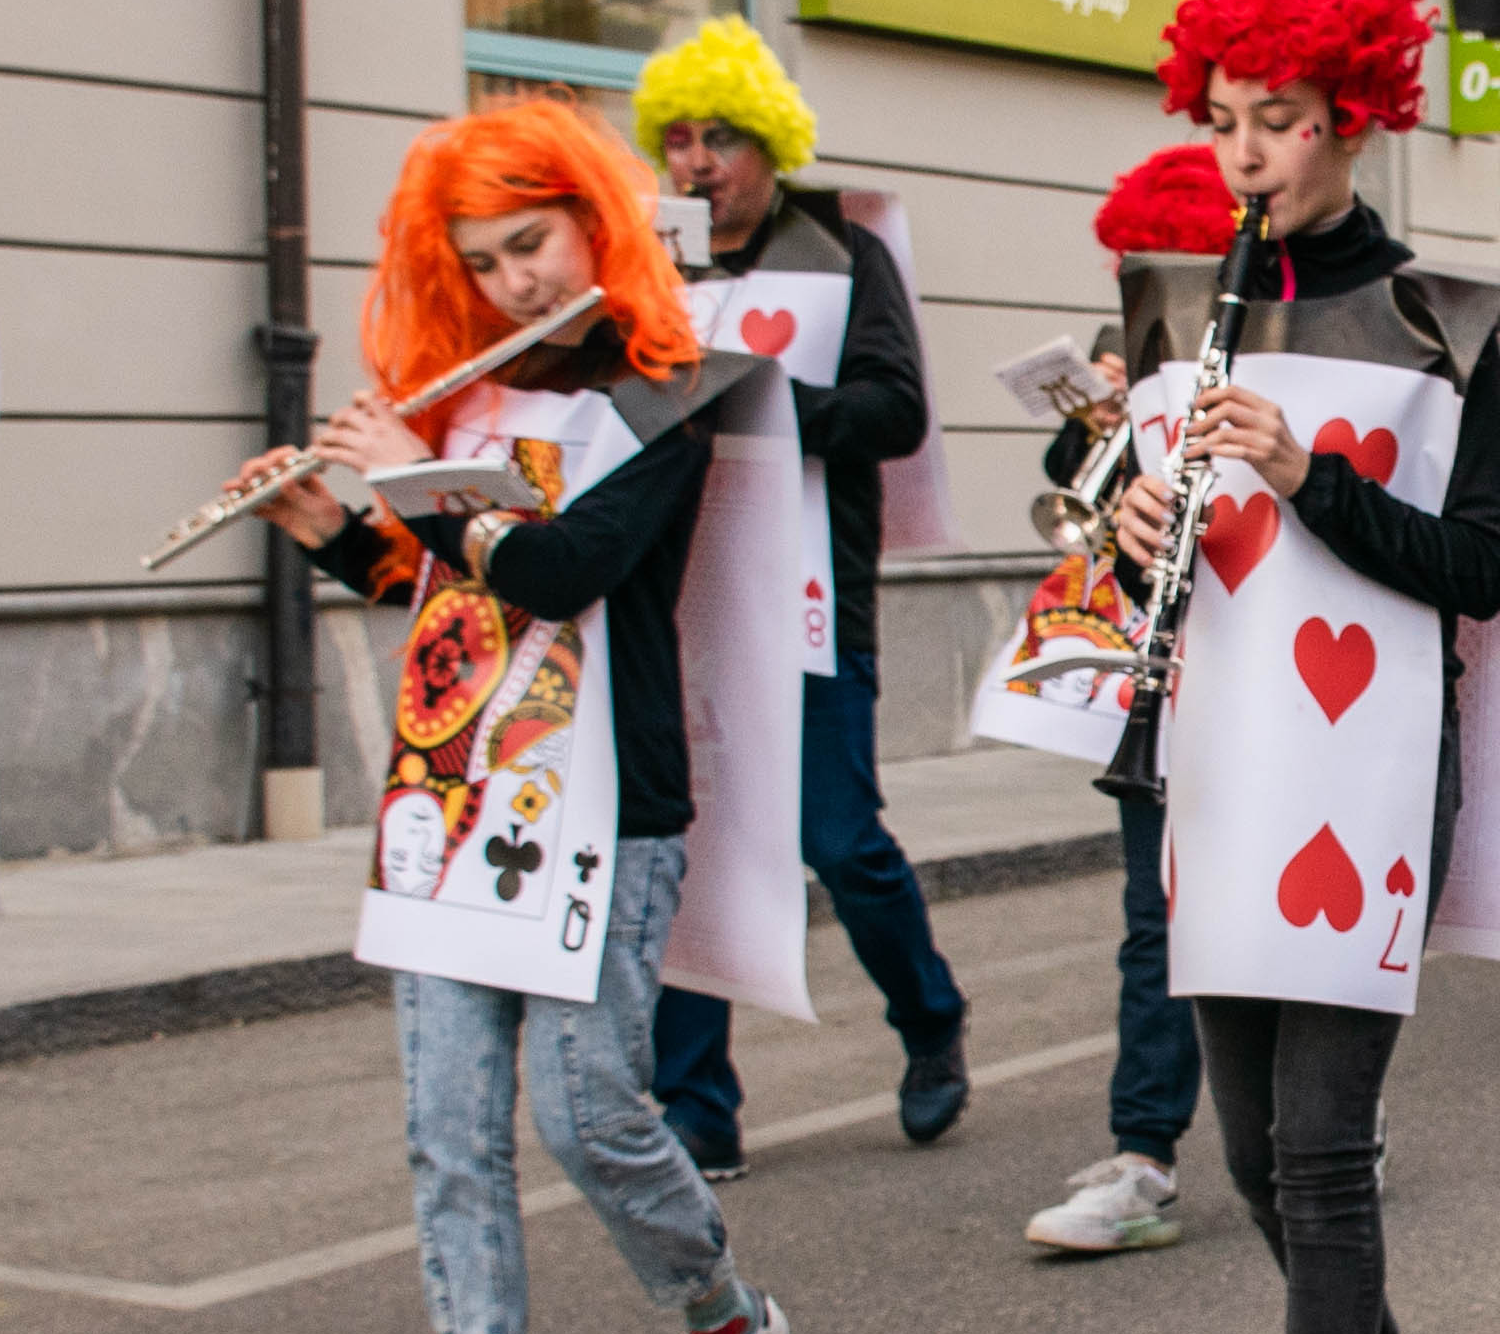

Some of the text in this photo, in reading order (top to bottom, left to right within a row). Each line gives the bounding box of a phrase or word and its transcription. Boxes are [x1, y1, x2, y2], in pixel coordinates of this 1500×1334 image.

[1141, 413, 1171, 454] 7
[804, 607, 827, 649] 8
[562, 891, 592, 951] Q
[1378, 907, 1409, 973] 7
